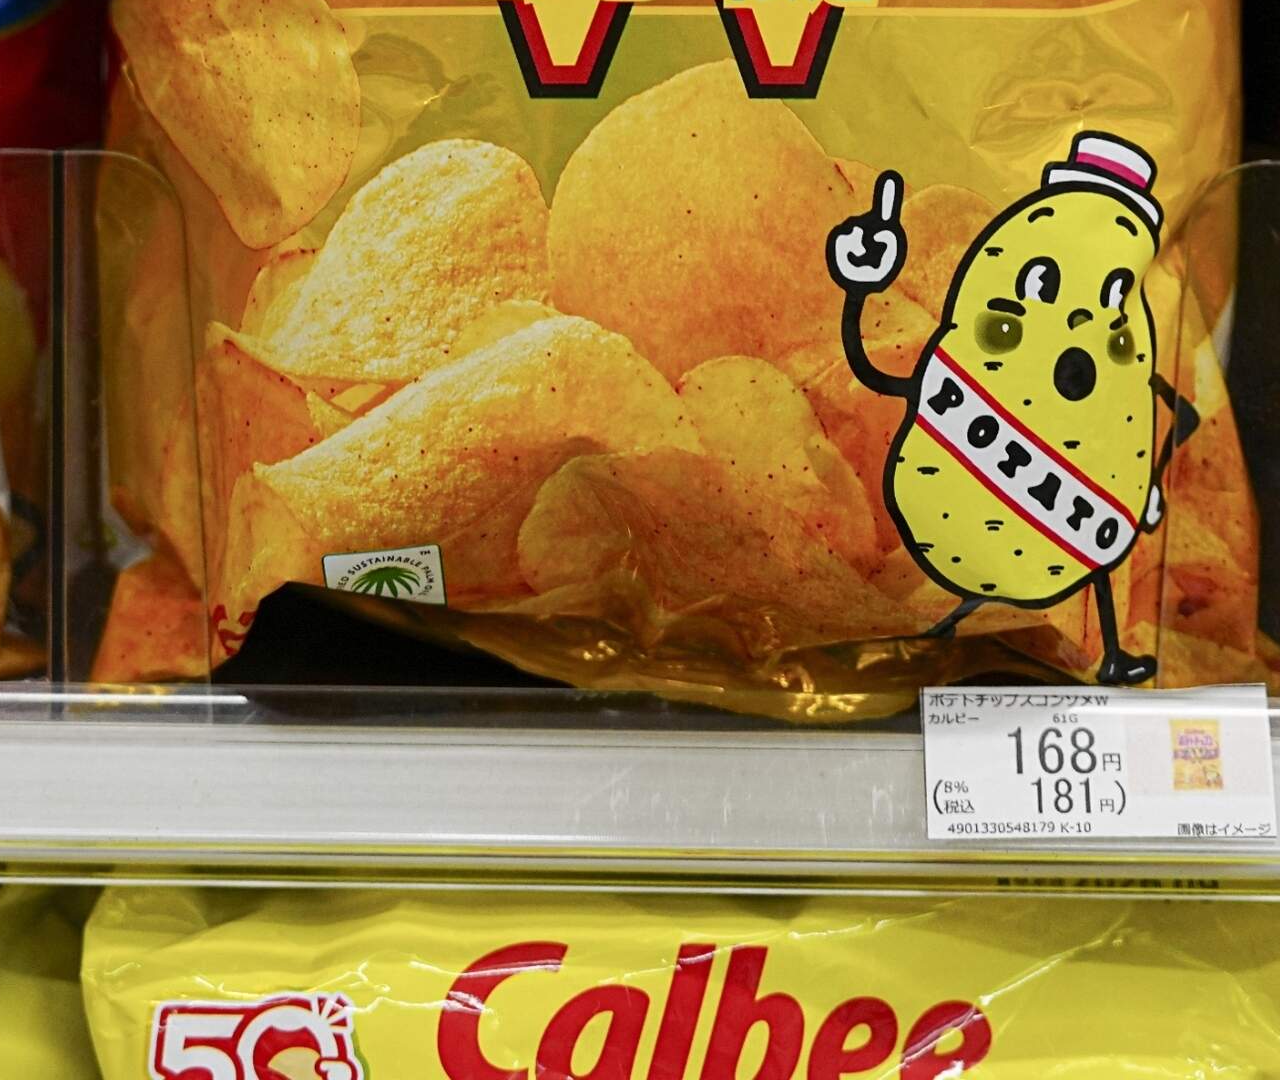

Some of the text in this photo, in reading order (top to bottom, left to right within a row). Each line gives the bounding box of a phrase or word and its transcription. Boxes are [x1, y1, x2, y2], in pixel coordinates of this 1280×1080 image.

[926, 376, 1119, 550] POTATO
[347, 555, 423, 576] SUSTAINABLE
[928, 713, 981, 726] カルビー
[946, 821, 1057, 835] 4901330548179
[1176, 822, 1273, 837] 画像はイメージ
[437, 941, 994, 1080] Calbee
